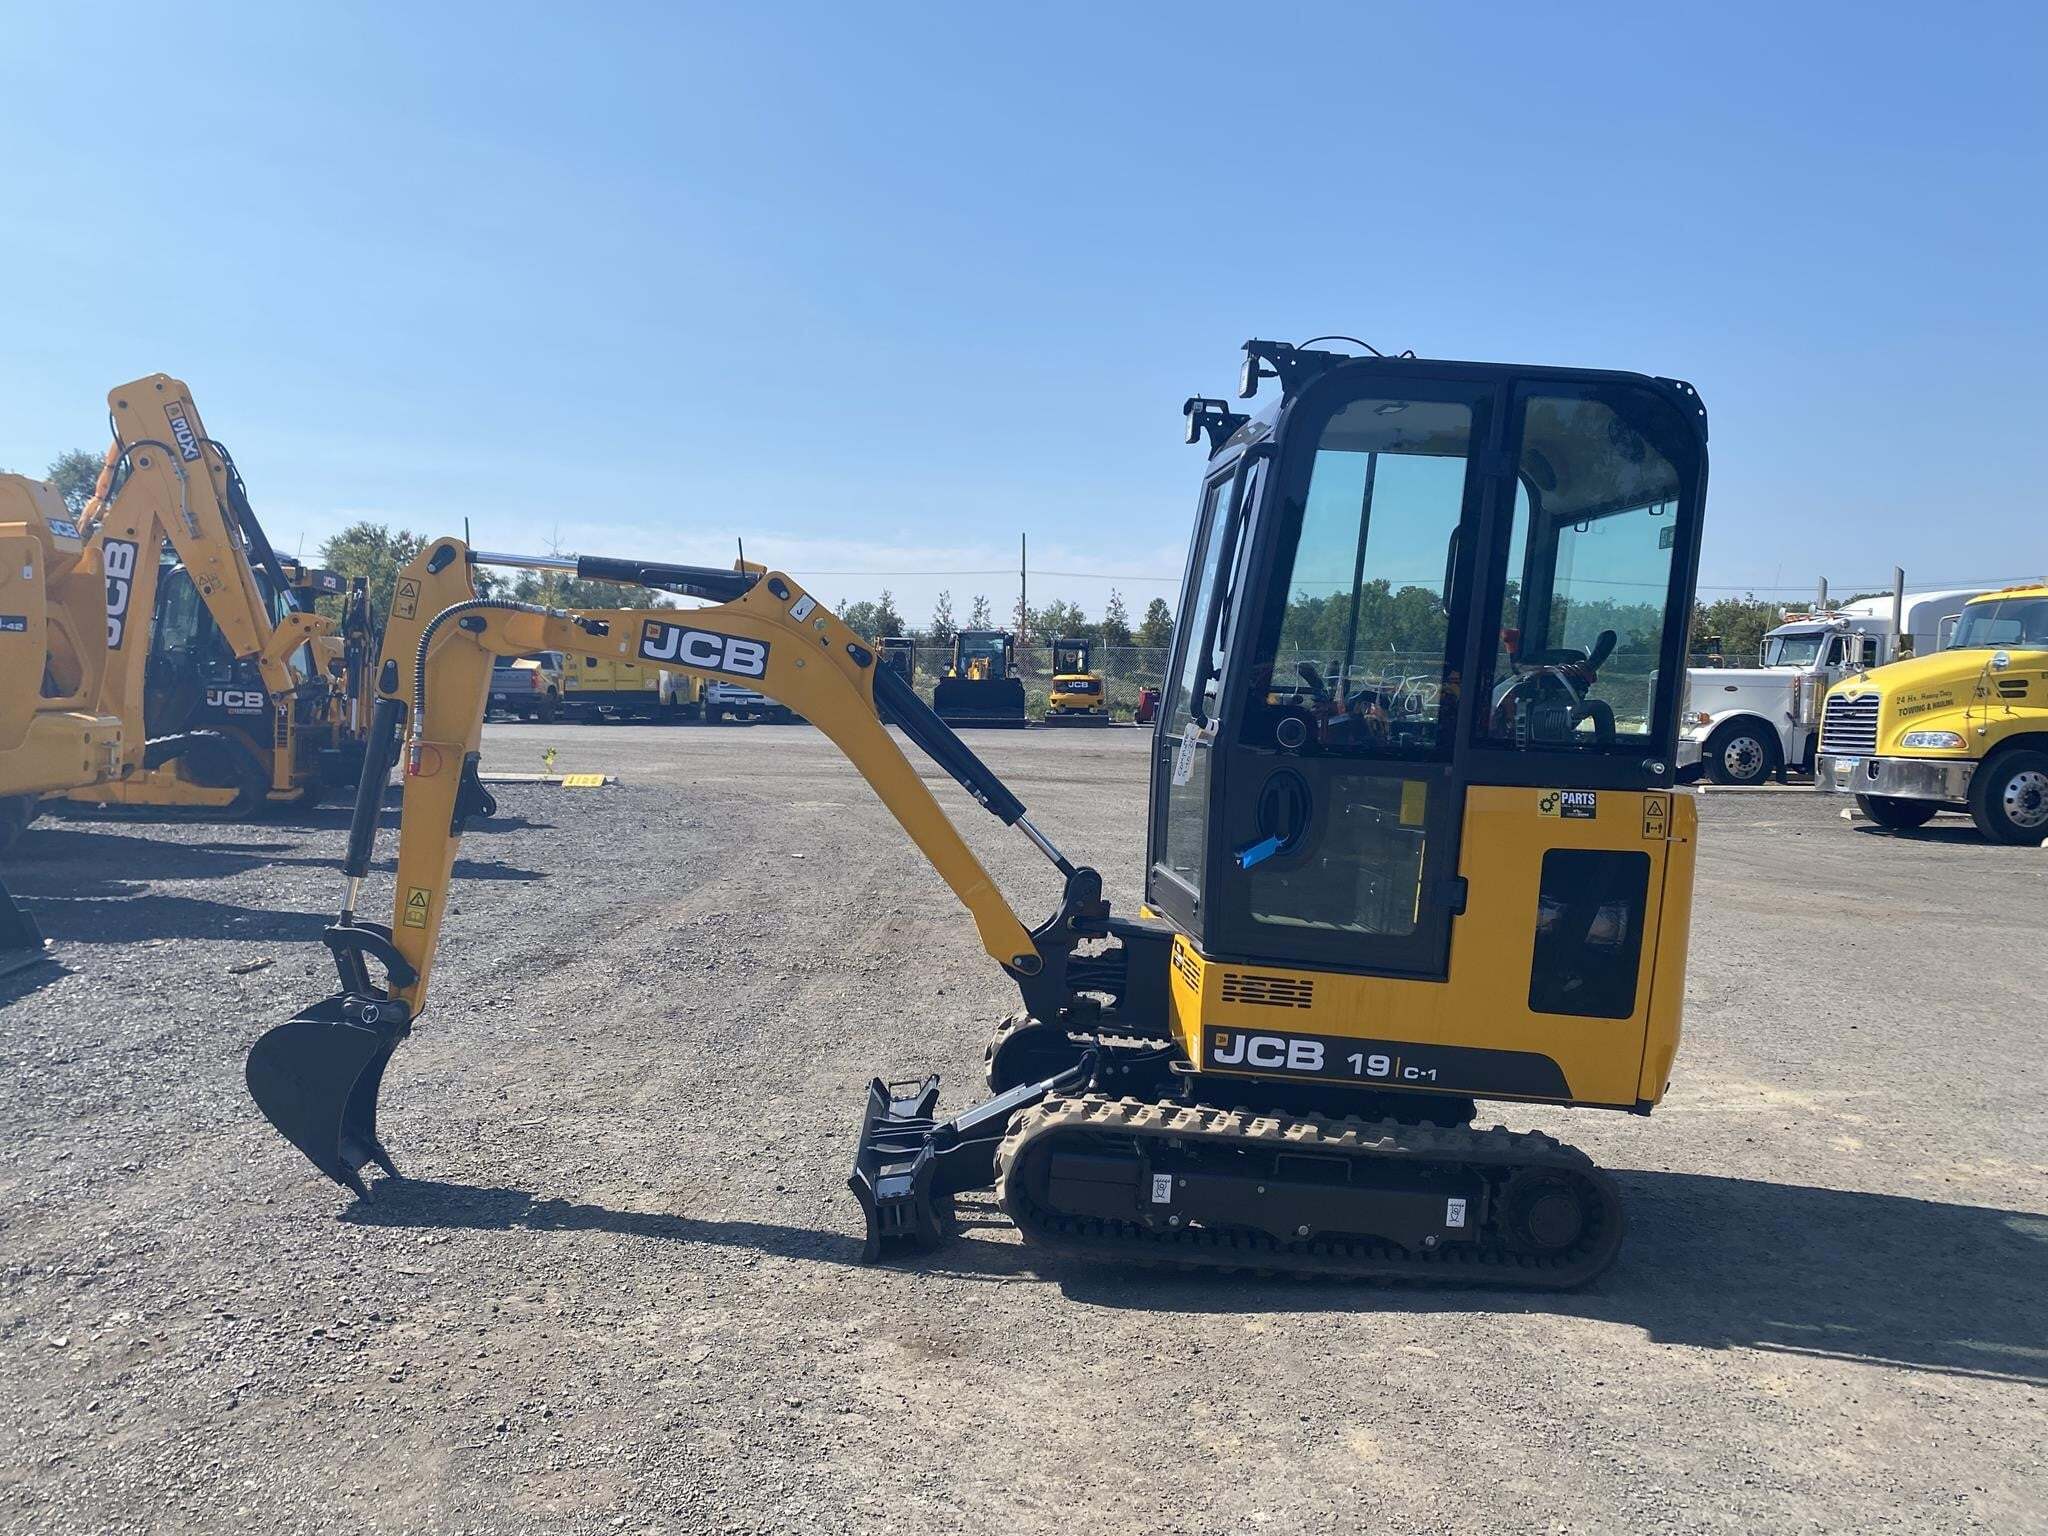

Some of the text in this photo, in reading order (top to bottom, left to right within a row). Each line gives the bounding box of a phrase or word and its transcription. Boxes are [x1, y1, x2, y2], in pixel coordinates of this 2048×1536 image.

[0, 616, 24, 631] -42
[643, 627, 765, 675] JCB
[1067, 681, 1089, 689] JCB
[206, 690, 264, 708] JCB
[1896, 704, 1926, 717] TOWING
[1561, 791, 1596, 805] PARTS
[1213, 1034, 1325, 1072] JCB
